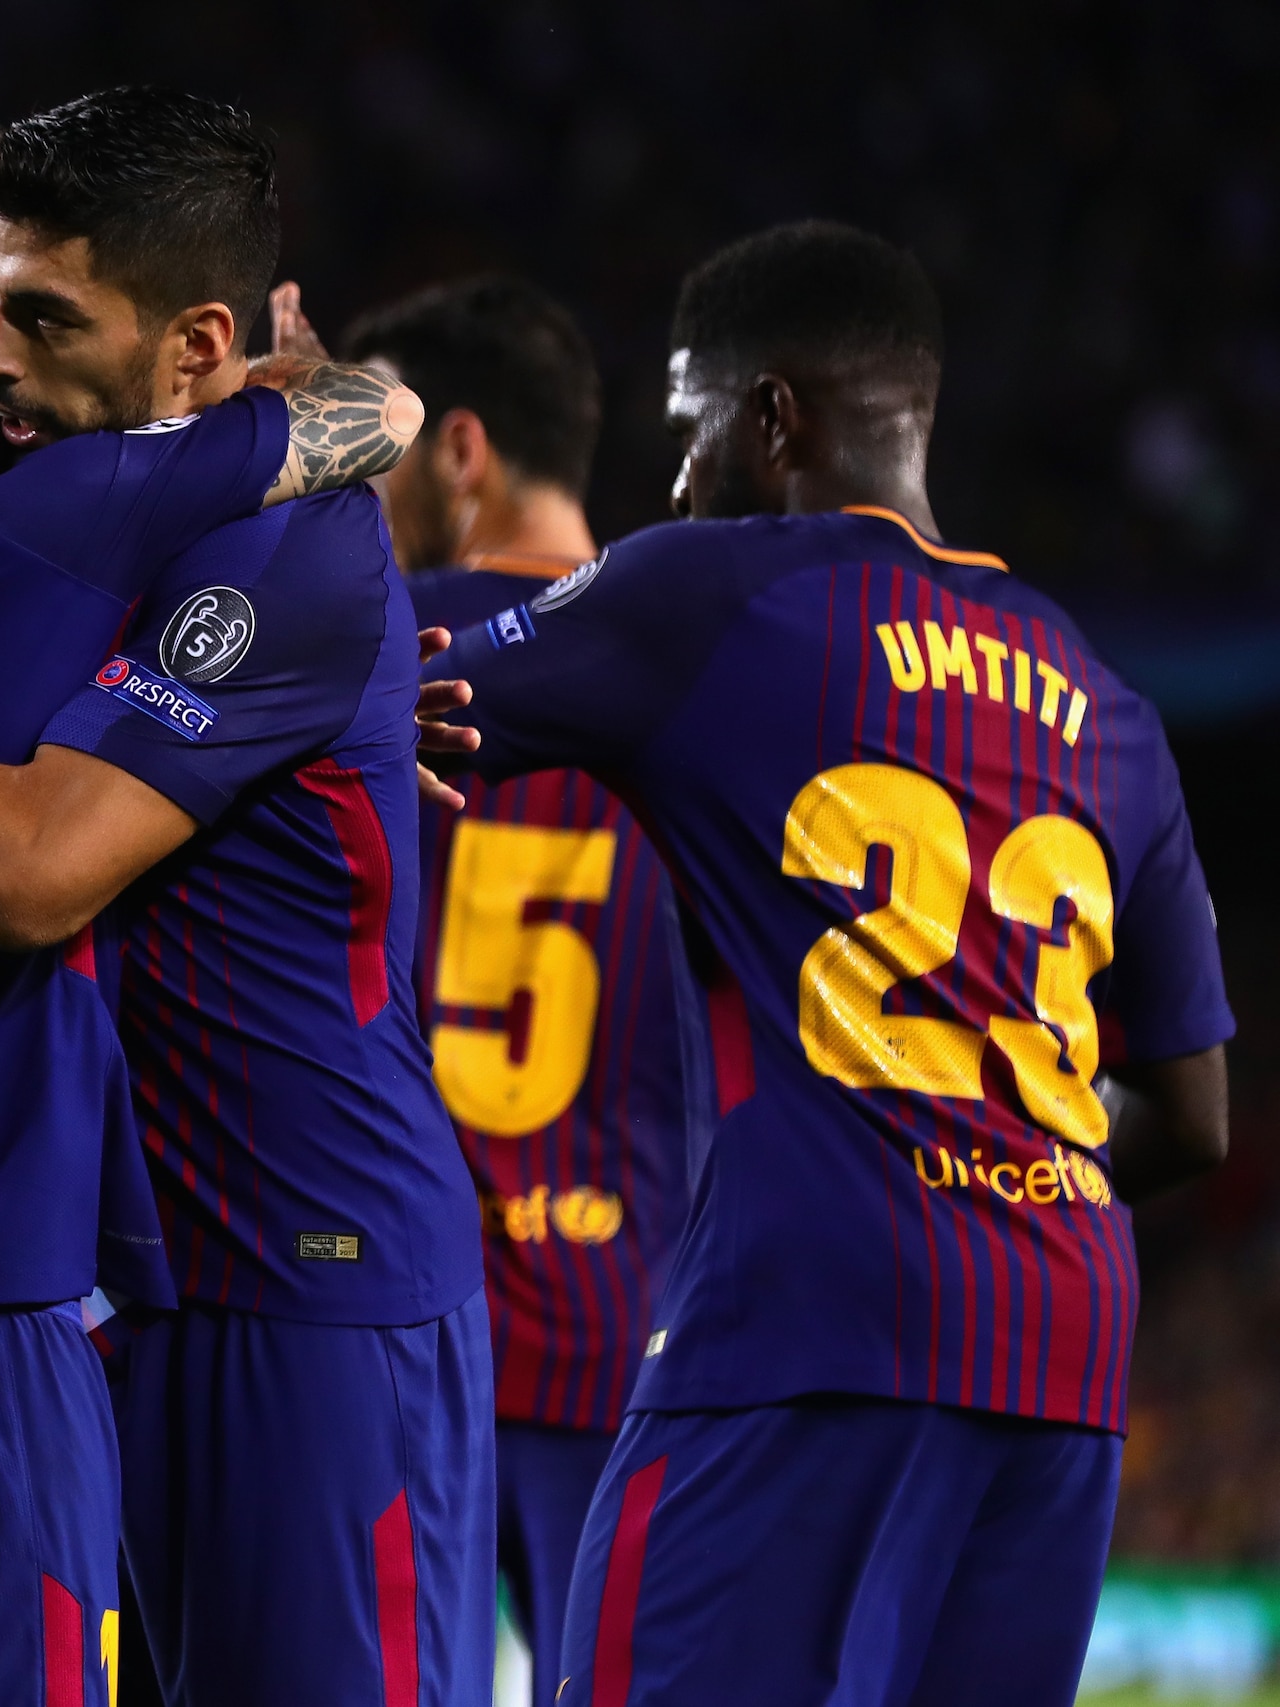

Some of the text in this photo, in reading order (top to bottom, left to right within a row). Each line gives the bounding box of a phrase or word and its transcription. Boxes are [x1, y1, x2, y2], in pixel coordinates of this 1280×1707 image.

[123, 675, 213, 734] RESPECT
[186, 632, 214, 657] 5
[875, 619, 1088, 748] UMTITI
[432, 819, 618, 1138] 5
[782, 763, 1113, 1149] 23
